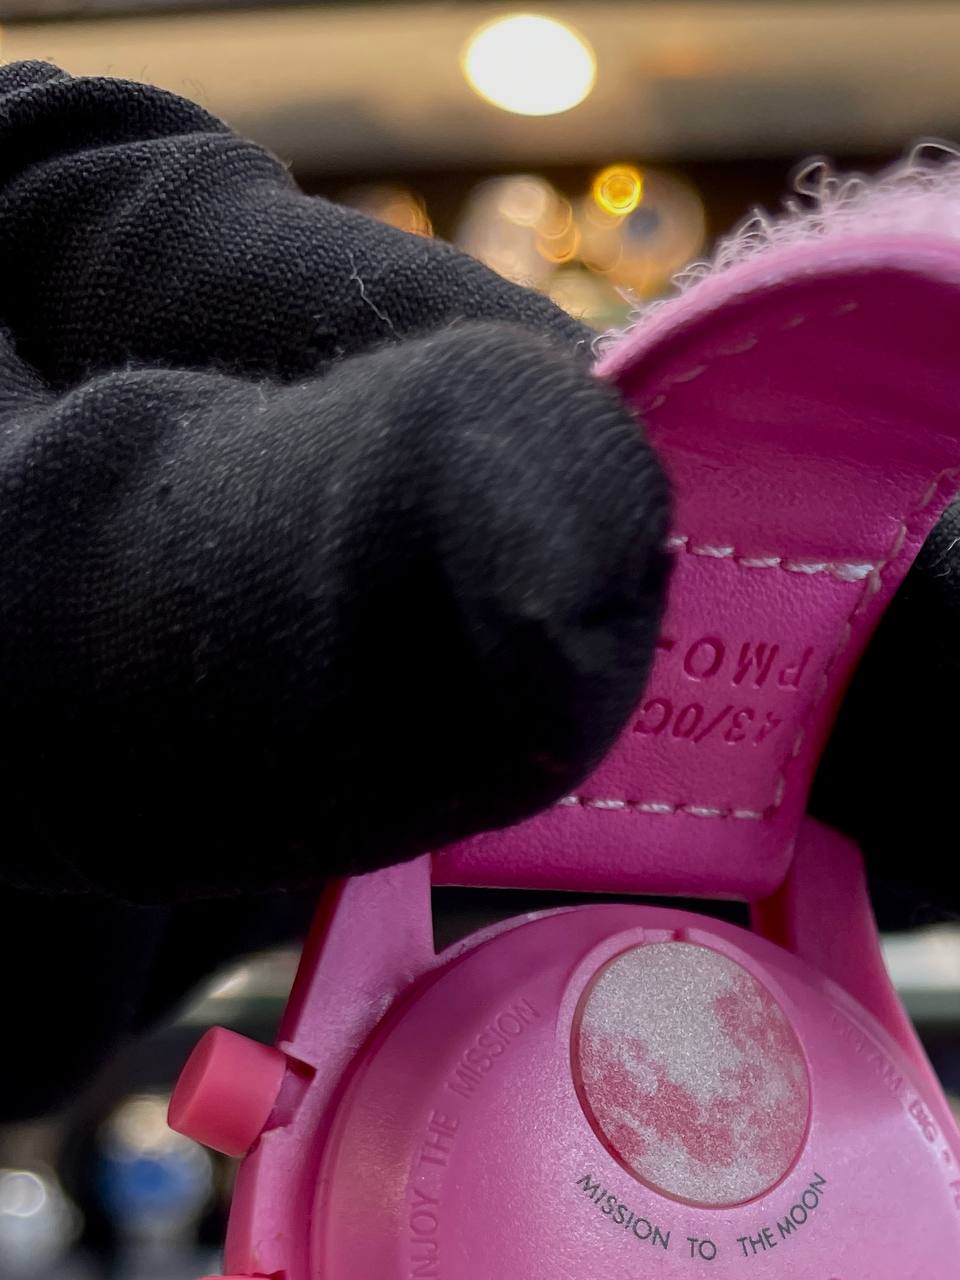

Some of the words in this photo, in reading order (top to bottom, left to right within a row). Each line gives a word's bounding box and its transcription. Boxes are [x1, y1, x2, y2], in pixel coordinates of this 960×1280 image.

[418, 1109, 461, 1168] THE
[449, 996, 542, 1100] MISSION
[576, 1173, 671, 1250] MISSION
[687, 1237, 718, 1261] TO
[736, 1227, 778, 1257] THE
[776, 1172, 828, 1241] MOON
